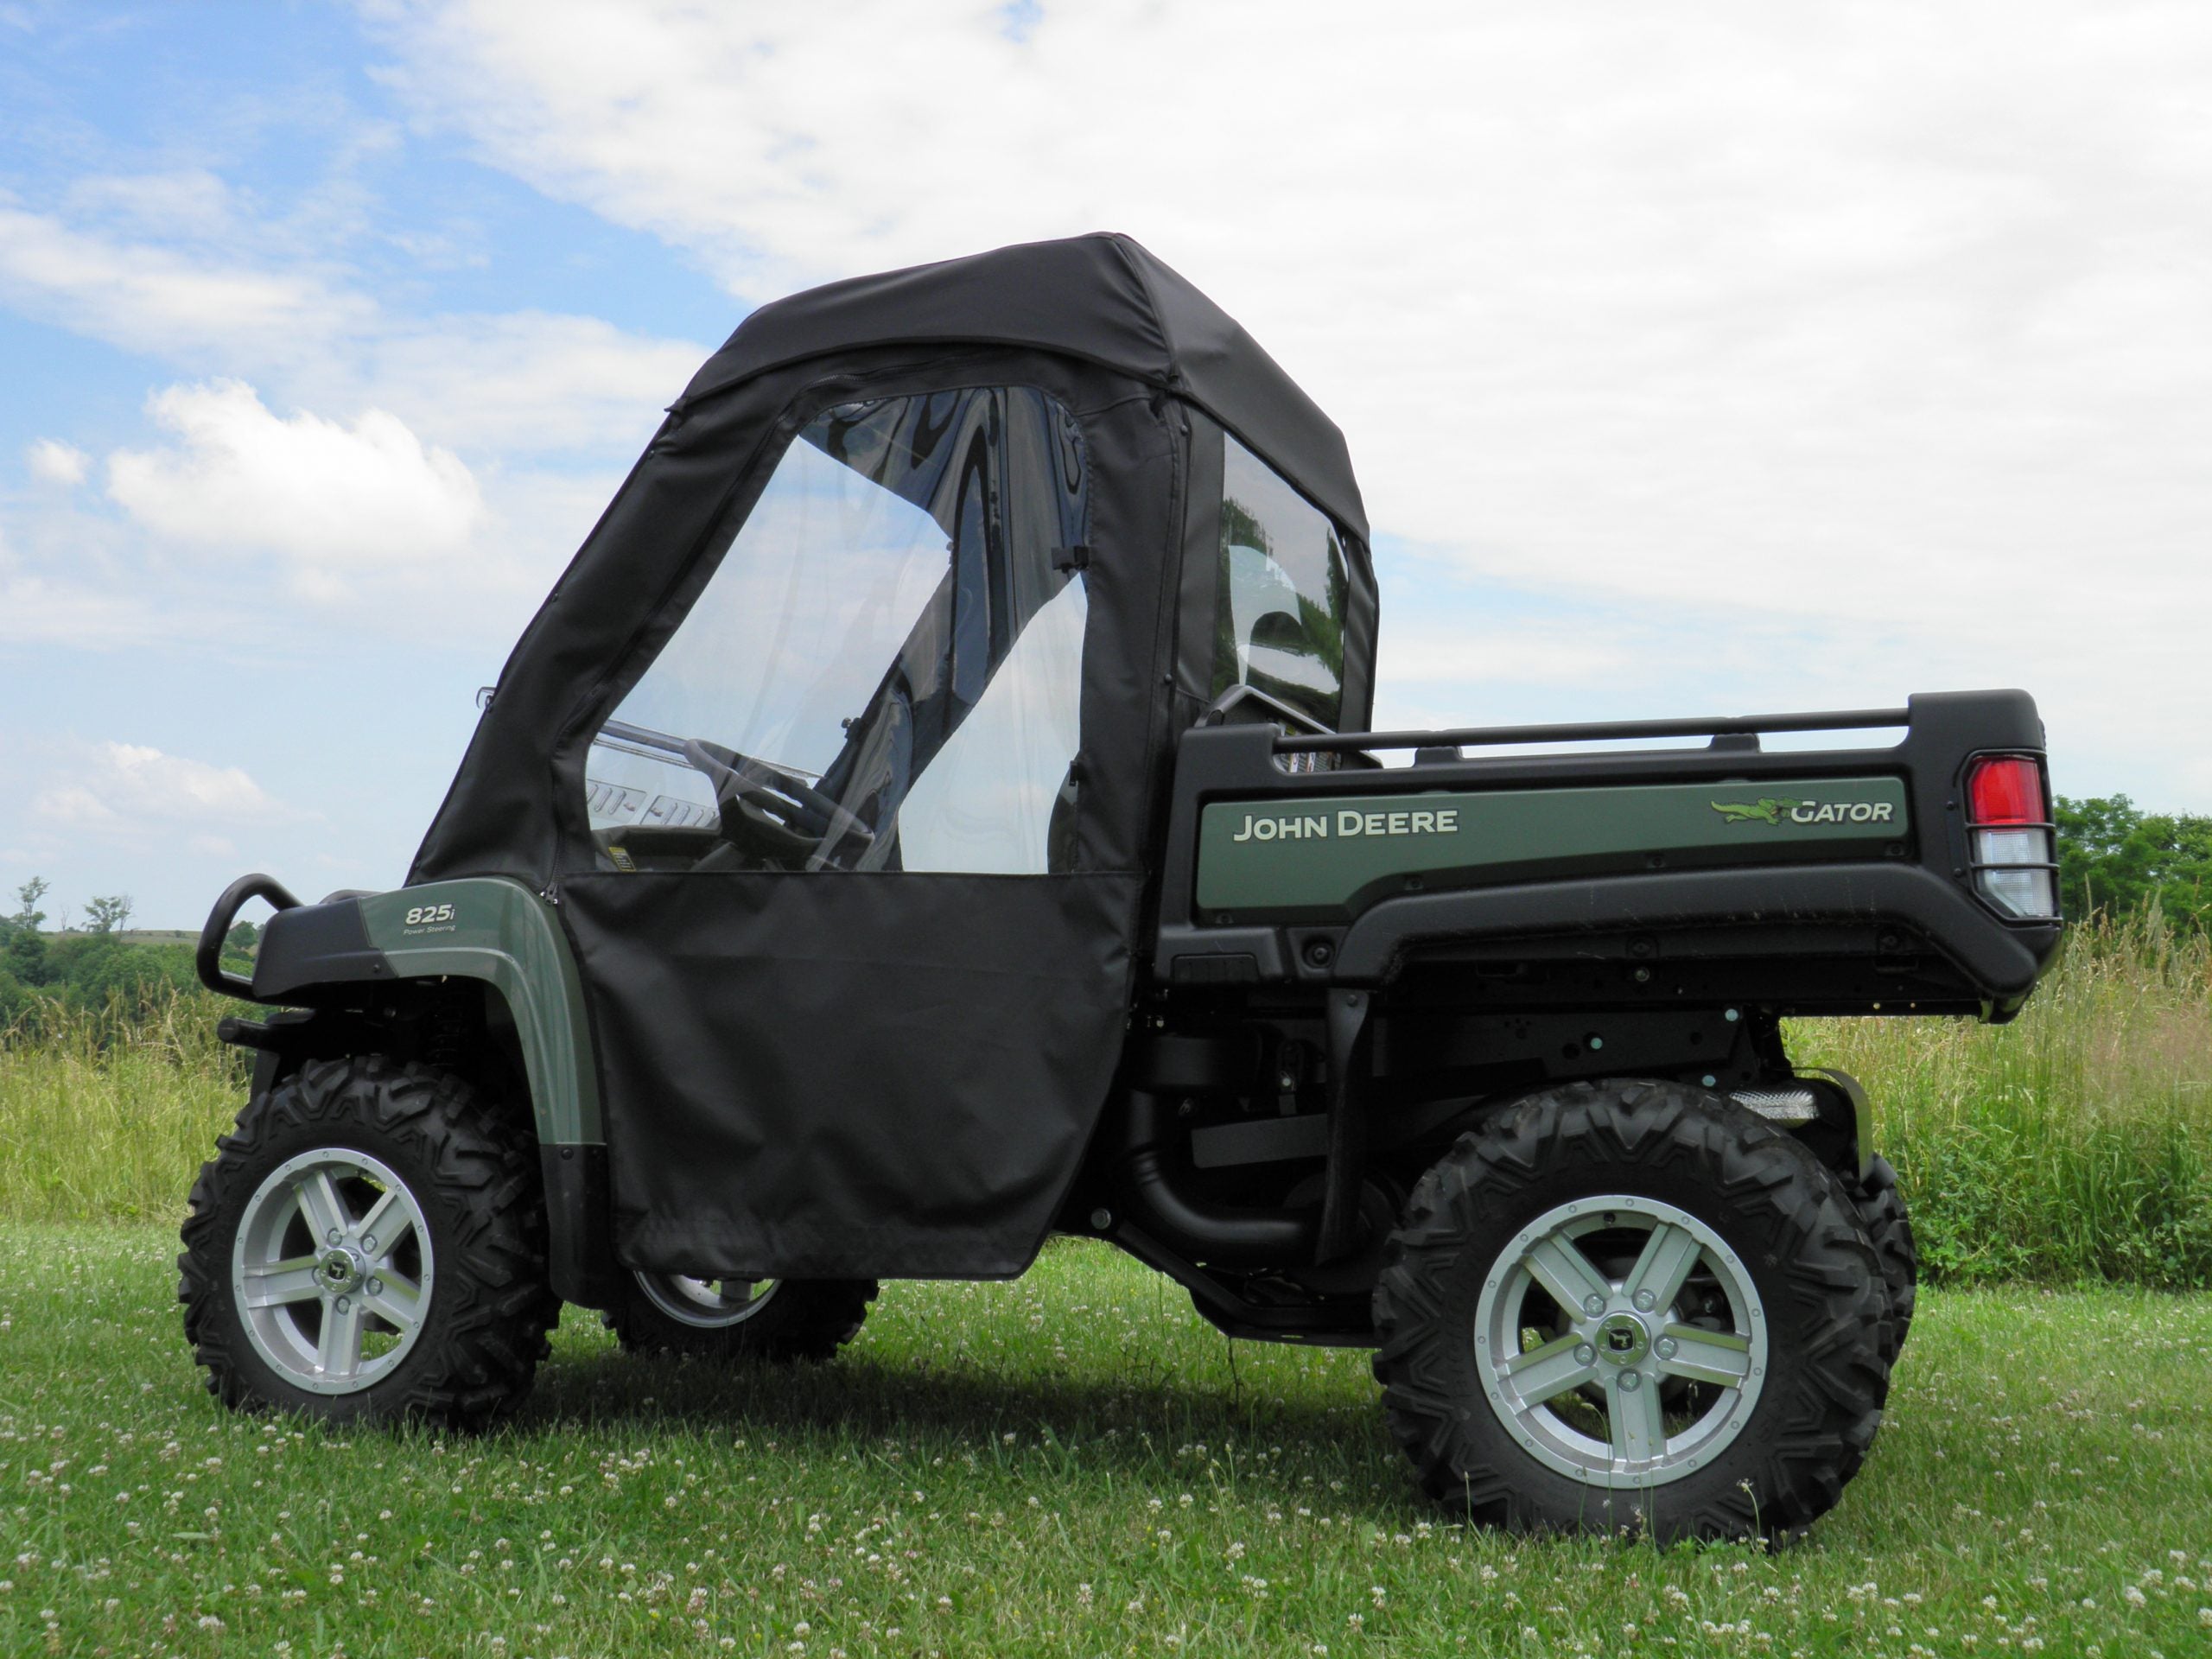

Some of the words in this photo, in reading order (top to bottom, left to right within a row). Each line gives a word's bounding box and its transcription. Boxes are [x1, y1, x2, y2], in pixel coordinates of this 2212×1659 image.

[1790, 800, 1893, 823] GATOR
[1233, 815, 1327, 842] JOHN
[1338, 810, 1458, 836] DEERE
[405, 904, 456, 925] 825i
[427, 925, 456, 933] Steering
